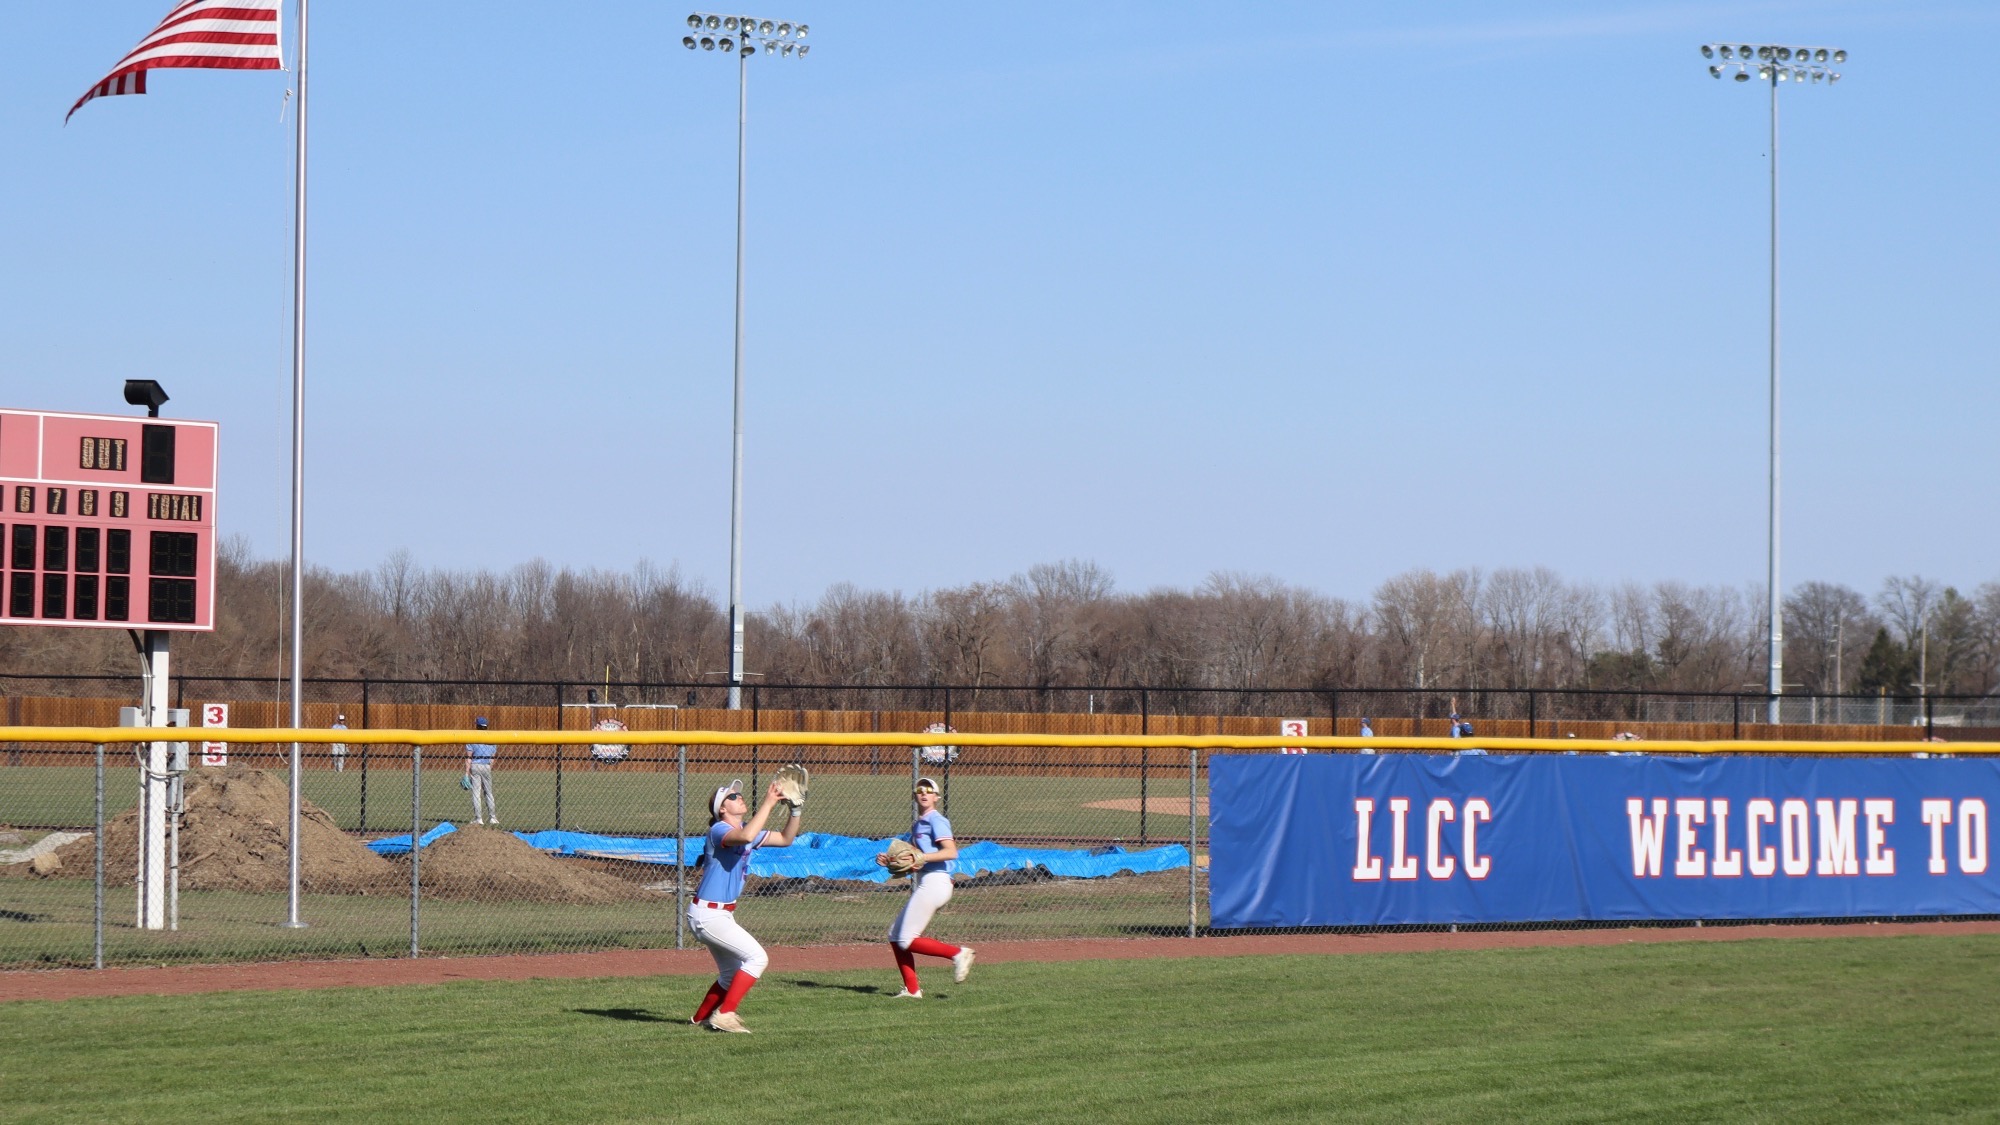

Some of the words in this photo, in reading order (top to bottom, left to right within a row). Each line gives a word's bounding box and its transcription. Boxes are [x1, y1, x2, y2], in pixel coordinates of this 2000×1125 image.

[82, 437, 125, 470] OUT
[20, 487, 31, 512] 6
[52, 488, 62, 514] 7
[83, 490, 94, 516] 8
[114, 492, 125, 517] 9
[151, 493, 200, 521] TOTAL
[1352, 798, 1491, 881] LLCC
[1626, 798, 1895, 877] WELCOME
[1921, 798, 1988, 874] TO
